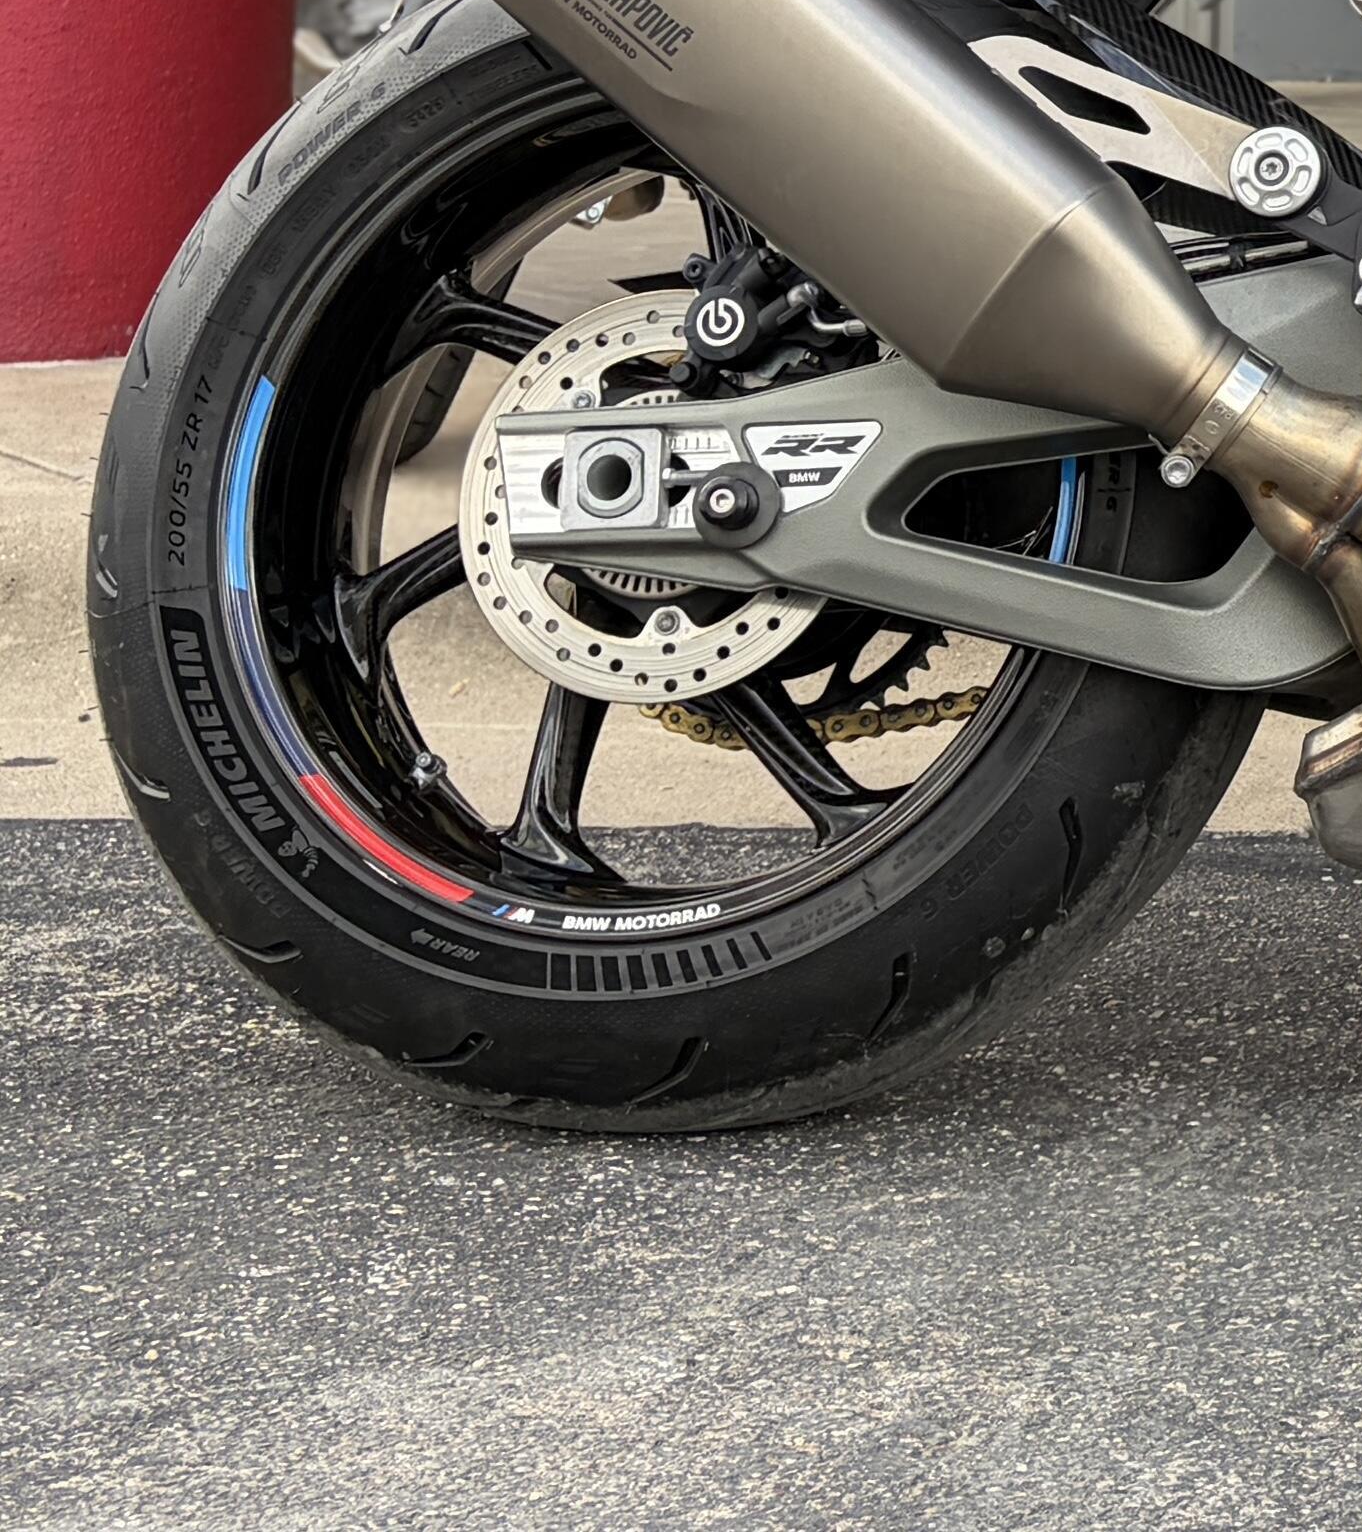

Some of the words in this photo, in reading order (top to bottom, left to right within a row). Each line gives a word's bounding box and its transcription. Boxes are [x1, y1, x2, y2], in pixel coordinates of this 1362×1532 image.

[572, 0, 638, 60] MOTORRAD
[761, 435, 867, 457] RR
[167, 459, 192, 567] 200/55
[181, 411, 206, 452] ZR
[194, 374, 213, 405] 17
[788, 472, 821, 484] BMW
[170, 629, 286, 833] MICHELIN
[562, 915, 611, 931] BMW
[614, 903, 721, 931] MOTORRAD
[430, 938, 480, 962] REAR
